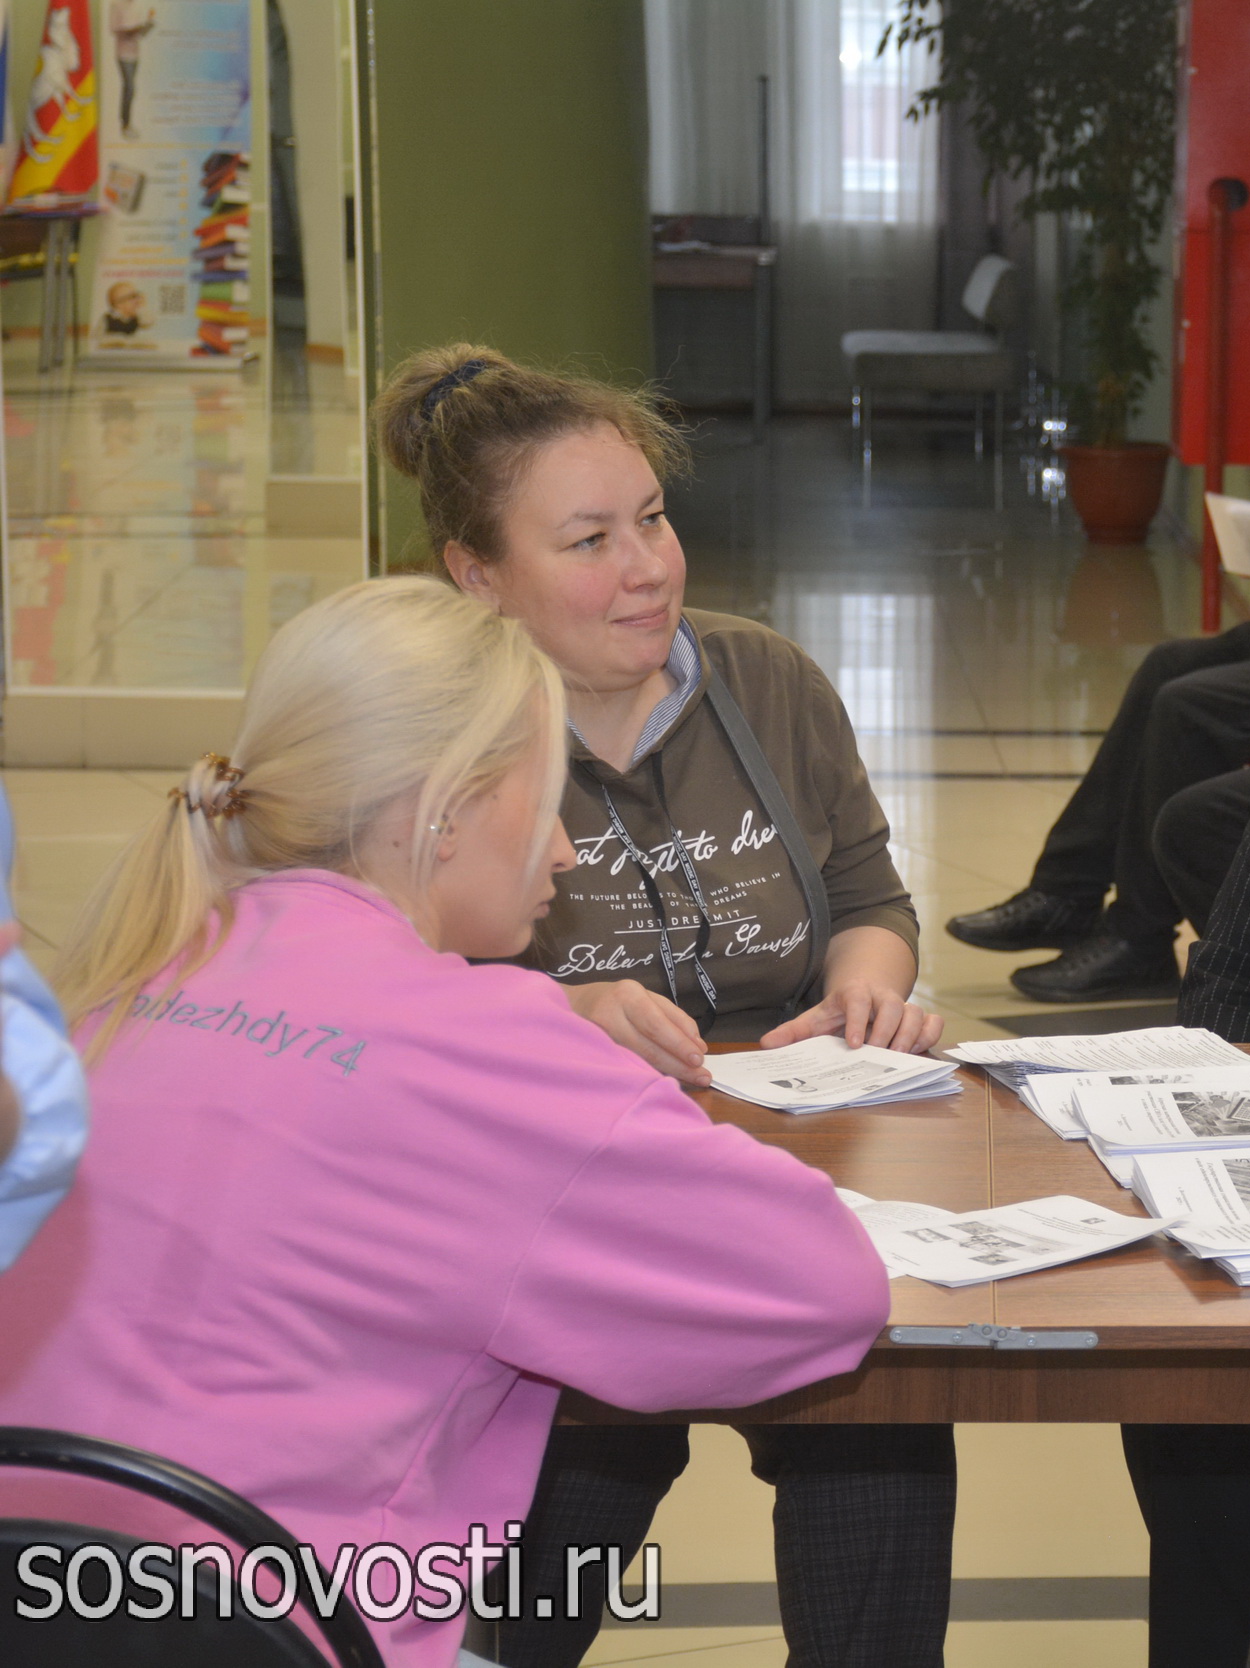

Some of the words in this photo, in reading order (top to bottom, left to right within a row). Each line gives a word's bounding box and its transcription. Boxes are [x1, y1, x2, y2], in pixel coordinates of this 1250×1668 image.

[574, 826, 618, 865] ot
[685, 829, 719, 861] to
[569, 893, 584, 901] THE
[590, 893, 620, 901] FUTURE
[627, 892, 663, 900] BELOS
[710, 886, 729, 897] WHO
[735, 877, 767, 888] BELIEVE
[713, 891, 748, 906] DREAMS
[100, 990, 369, 1077] adezhdy74
